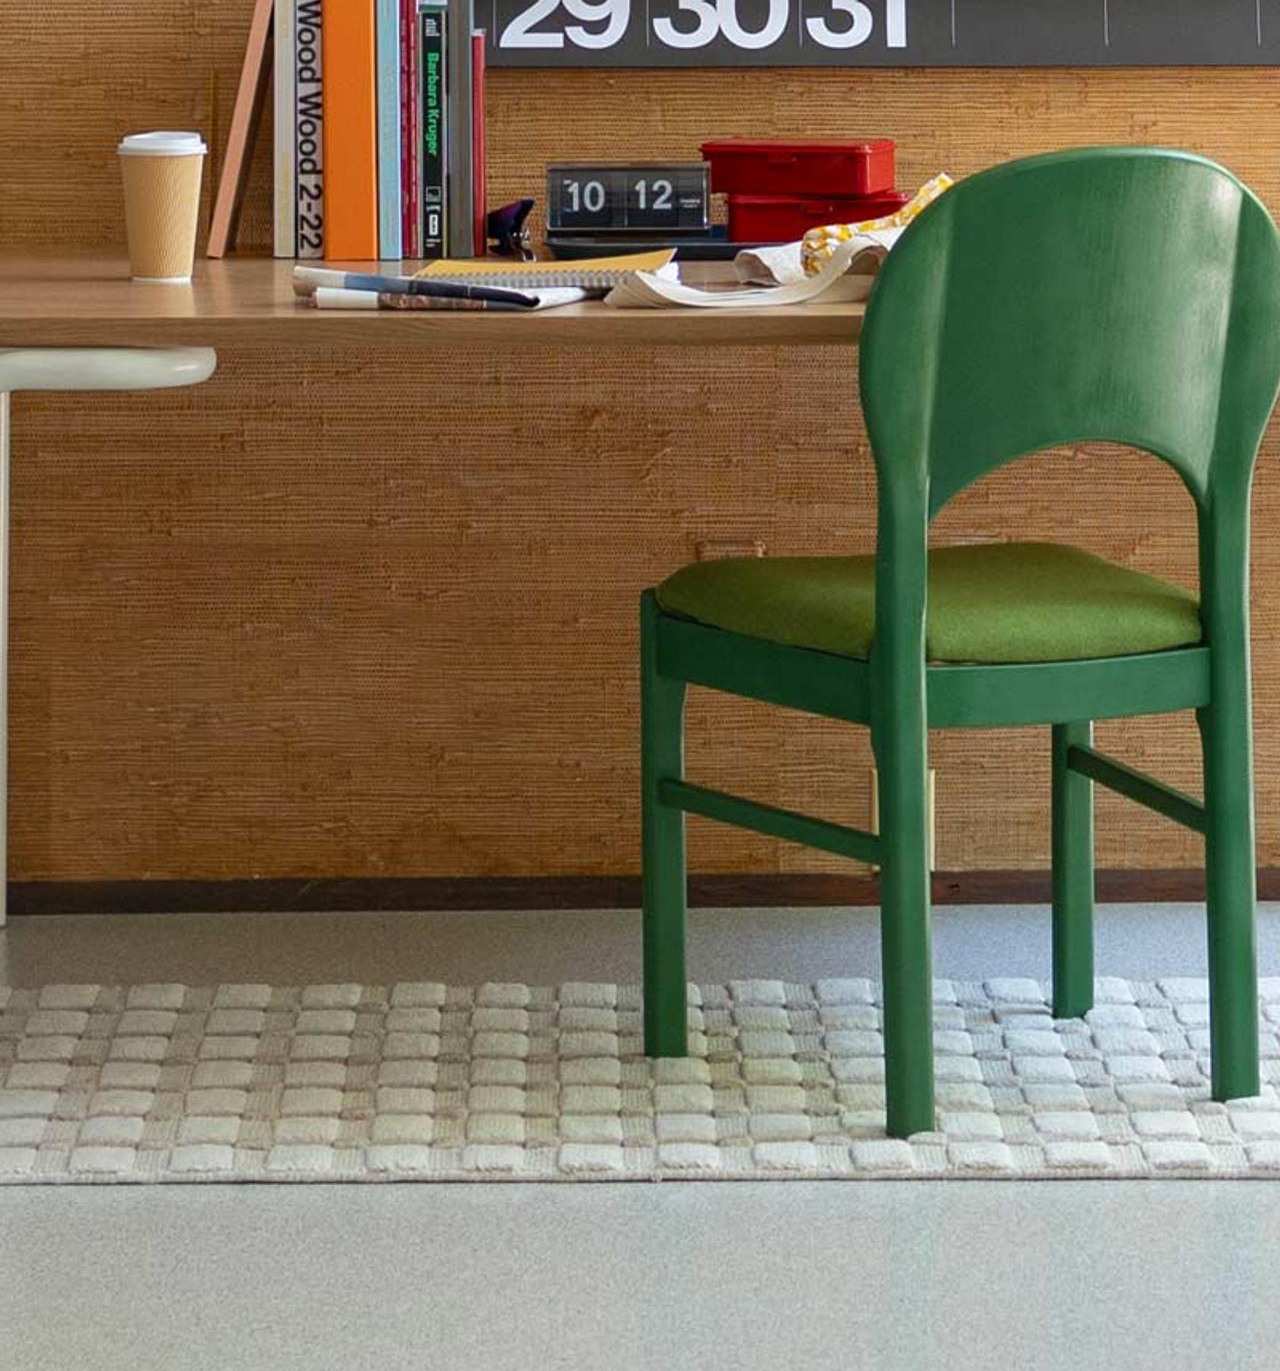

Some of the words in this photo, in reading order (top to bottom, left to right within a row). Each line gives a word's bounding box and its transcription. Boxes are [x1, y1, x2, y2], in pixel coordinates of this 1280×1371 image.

[427, 52, 440, 107] Barbara
[299, 91, 323, 176] Wood
[425, 108, 440, 157] Kruger
[299, 183, 323, 250] 2-22
[567, 180, 606, 212] 10
[634, 179, 673, 209] 12
